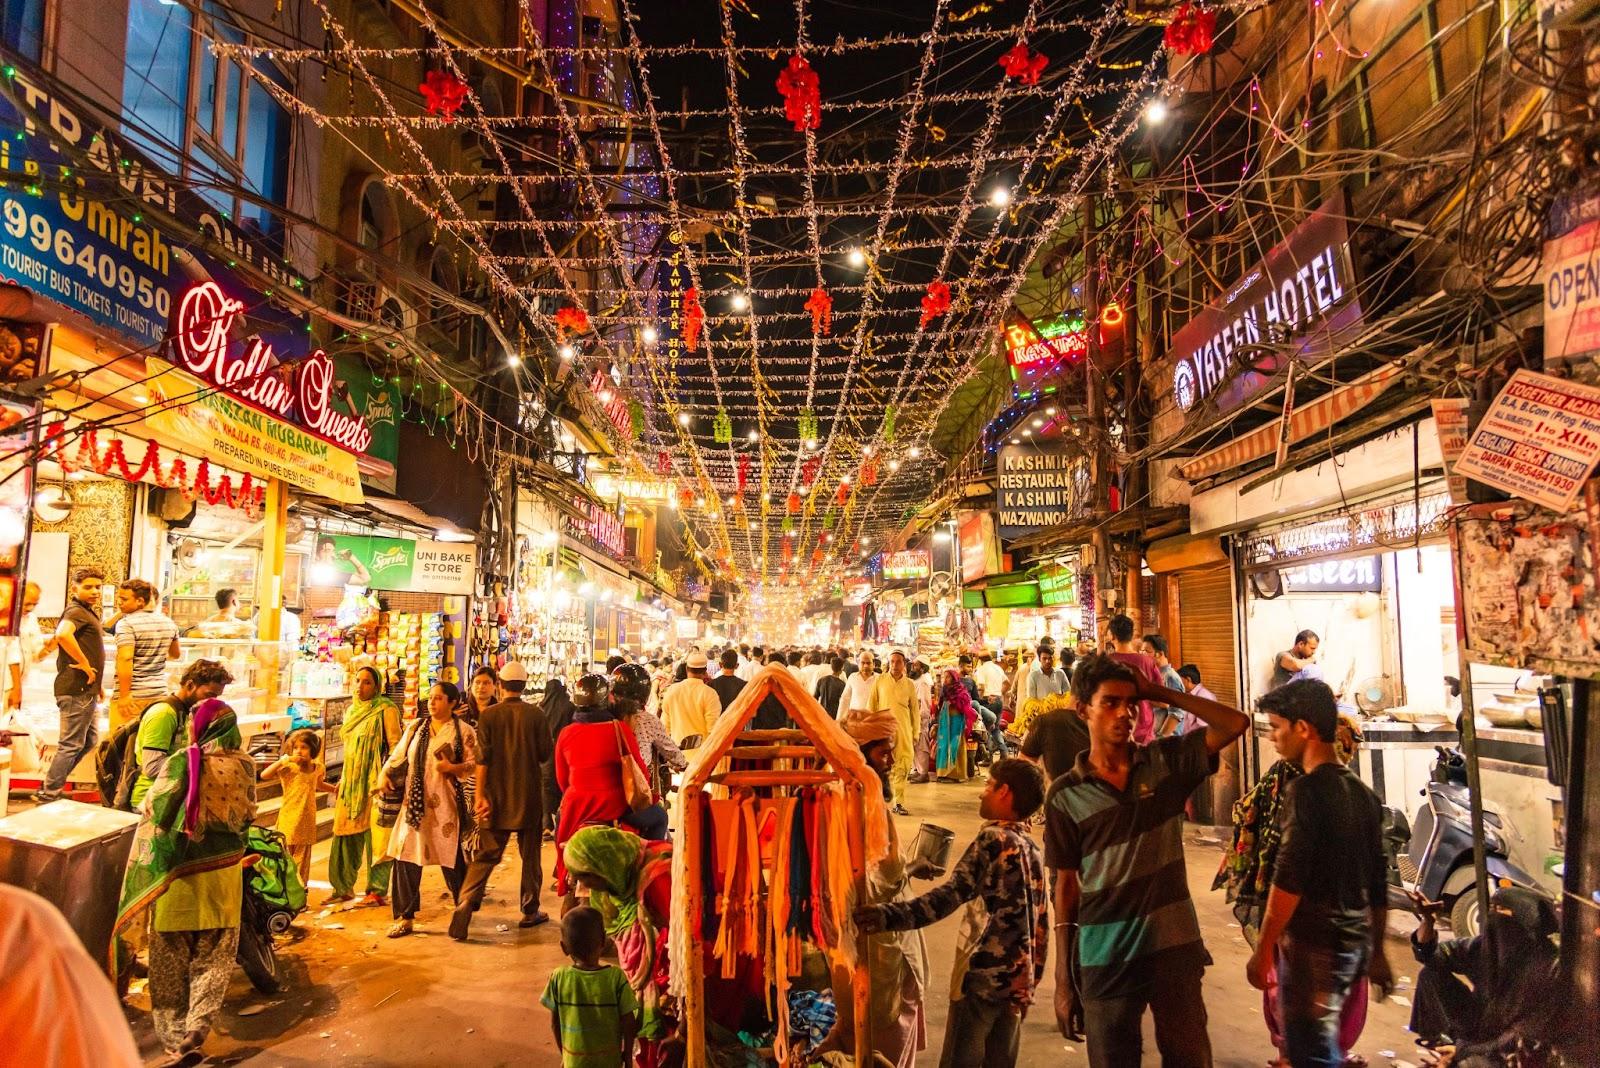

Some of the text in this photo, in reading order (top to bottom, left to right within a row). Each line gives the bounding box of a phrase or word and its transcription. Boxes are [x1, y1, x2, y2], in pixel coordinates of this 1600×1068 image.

[1, 244, 49, 285] TOURIST
[50, 269, 71, 297] BUS
[115, 303, 149, 334] TOURIST
[151, 325, 167, 342] VIS
[668, 252, 682, 393] JAWAHAR HOTE
[1193, 246, 1343, 399] YASEEN HOTEL
[301, 350, 372, 452] Sweets
[1508, 382, 1568, 408] TOGETHER
[366, 401, 393, 421] Sprite
[1520, 401, 1550, 417] B.Com
[1544, 426, 1556, 435] to
[1559, 428, 1598, 450] XIIth
[213, 438, 254, 464] PREPARED
[256, 458, 263, 468] IN
[264, 461, 282, 476] PURE
[283, 468, 299, 481] DESI
[299, 473, 316, 488] GHEE
[1475, 432, 1513, 456] ENGLISH
[1509, 443, 1546, 465] FRENCH
[1543, 453, 1587, 479] SPANISH
[1000, 473, 1068, 489] RESTAURA
[1480, 451, 1512, 469] DARPAN
[1513, 462, 1575, 491] 9654841930
[374, 551, 406, 569] Sprite
[416, 551, 472, 563] UNI BAKE
[423, 562, 462, 573] STORE
